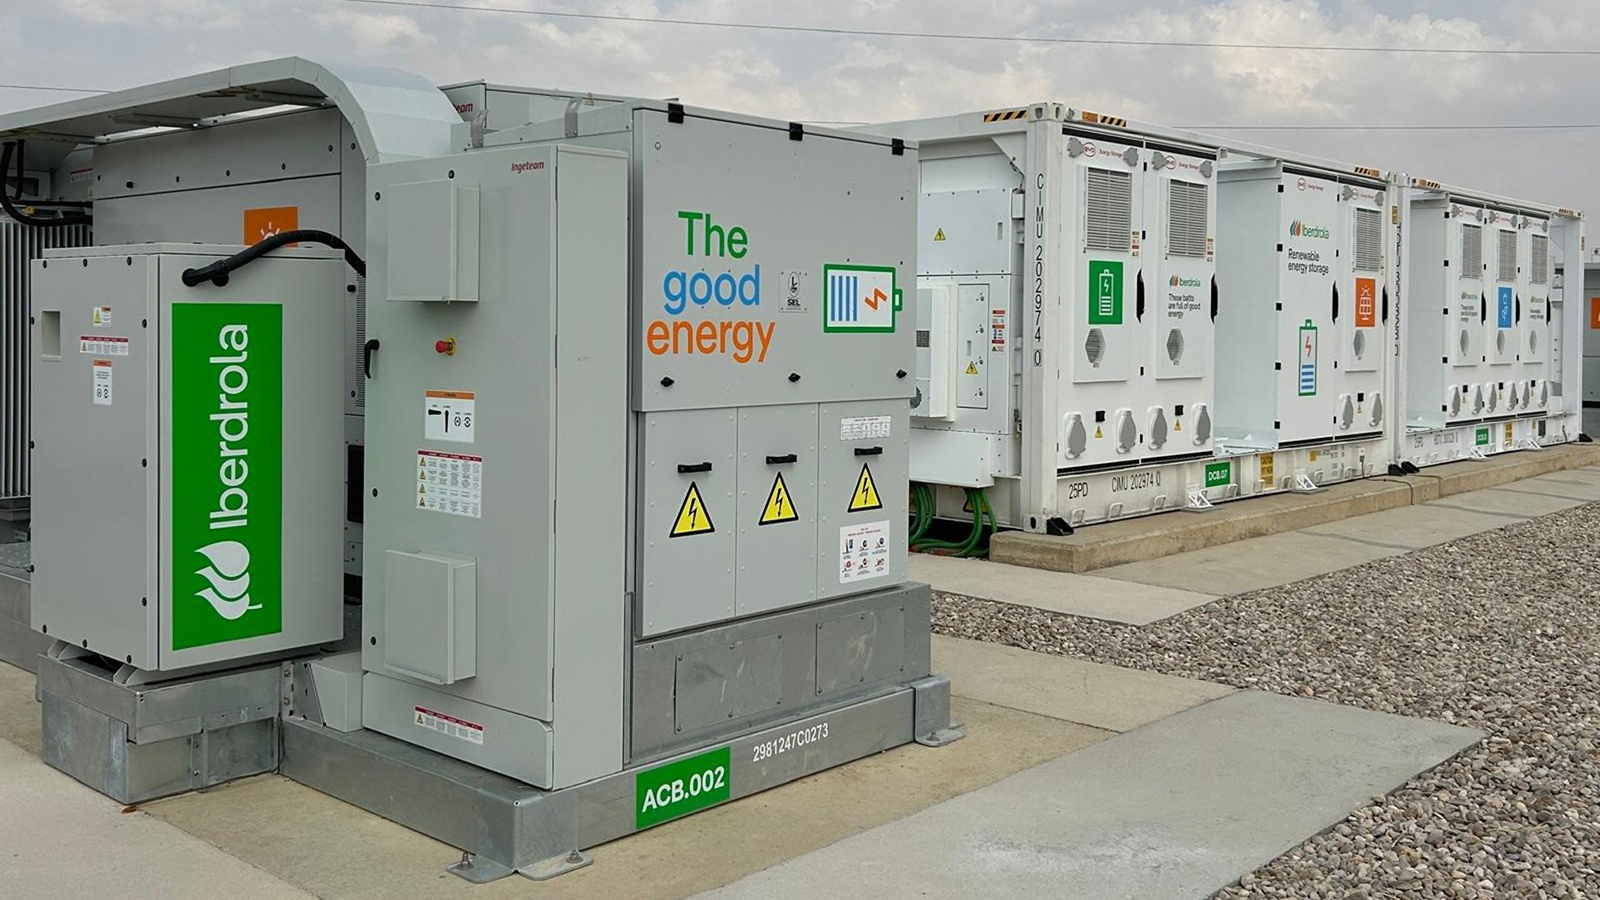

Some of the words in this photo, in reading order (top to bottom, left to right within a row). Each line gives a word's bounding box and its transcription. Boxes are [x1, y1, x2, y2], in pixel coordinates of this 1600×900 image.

[511, 161, 545, 174] Ingeteam
[1036, 173, 1044, 239] CIMU
[678, 211, 748, 259] The
[1302, 223, 1330, 239] Iberdrola
[1288, 248, 1320, 261] Renewable
[1288, 262, 1307, 274] energy
[1308, 262, 1329, 276] storage
[663, 264, 760, 316] good
[1034, 245, 1043, 343] 202974
[787, 298, 800, 306] SEL
[646, 320, 776, 364] energy
[1034, 350, 1042, 366] 0
[210, 325, 248, 530] Iberdrola
[1111, 476, 1128, 492] CIMU
[1130, 472, 1154, 490] 202974
[1155, 471, 1161, 487] 0
[1208, 469, 1228, 481] DCB.07
[1068, 482, 1089, 499] 25PD
[753, 723, 829, 762] 2981247C0273
[642, 765, 726, 813] ACB.002
